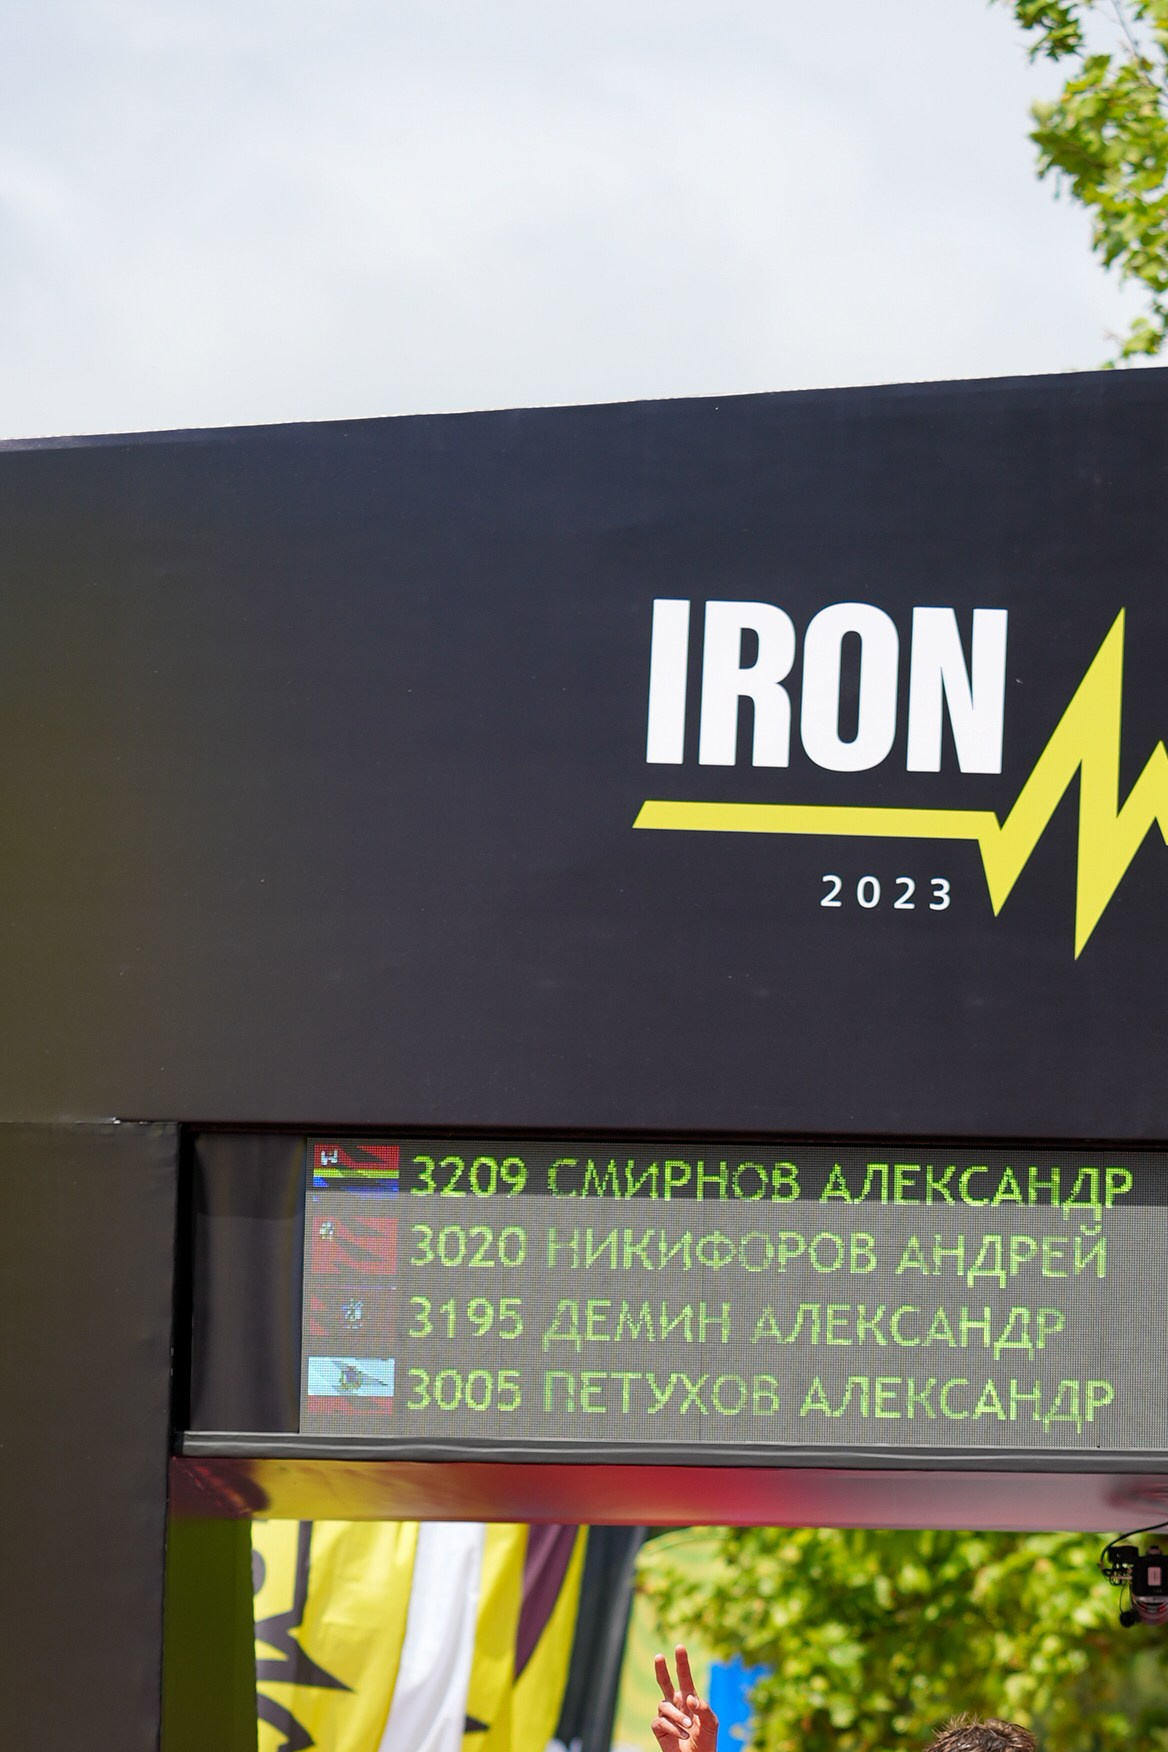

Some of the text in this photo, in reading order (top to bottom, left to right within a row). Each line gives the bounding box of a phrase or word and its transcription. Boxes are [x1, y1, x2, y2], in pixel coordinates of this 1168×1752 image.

[646, 598, 1008, 774] IRON
[820, 875, 952, 911] 2023
[410, 1154, 529, 1198] 3209
[547, 1157, 802, 1204] СМИРНОВ
[819, 1162, 1135, 1222] АЛЕКСАНДР
[410, 1224, 528, 1268] 3020
[547, 1227, 878, 1275] НИКИФОРОВ
[895, 1223, 1108, 1288] АНДРЕЙ
[408, 1295, 525, 1341] 3195
[541, 1298, 732, 1353] ДЕМИН
[751, 1302, 1066, 1361] АЛЕКСАНДР
[406, 1367, 523, 1413] 3005
[543, 1371, 780, 1419] ПЕТУХОВ
[798, 1375, 1116, 1434] АЛЕКСАНДР
